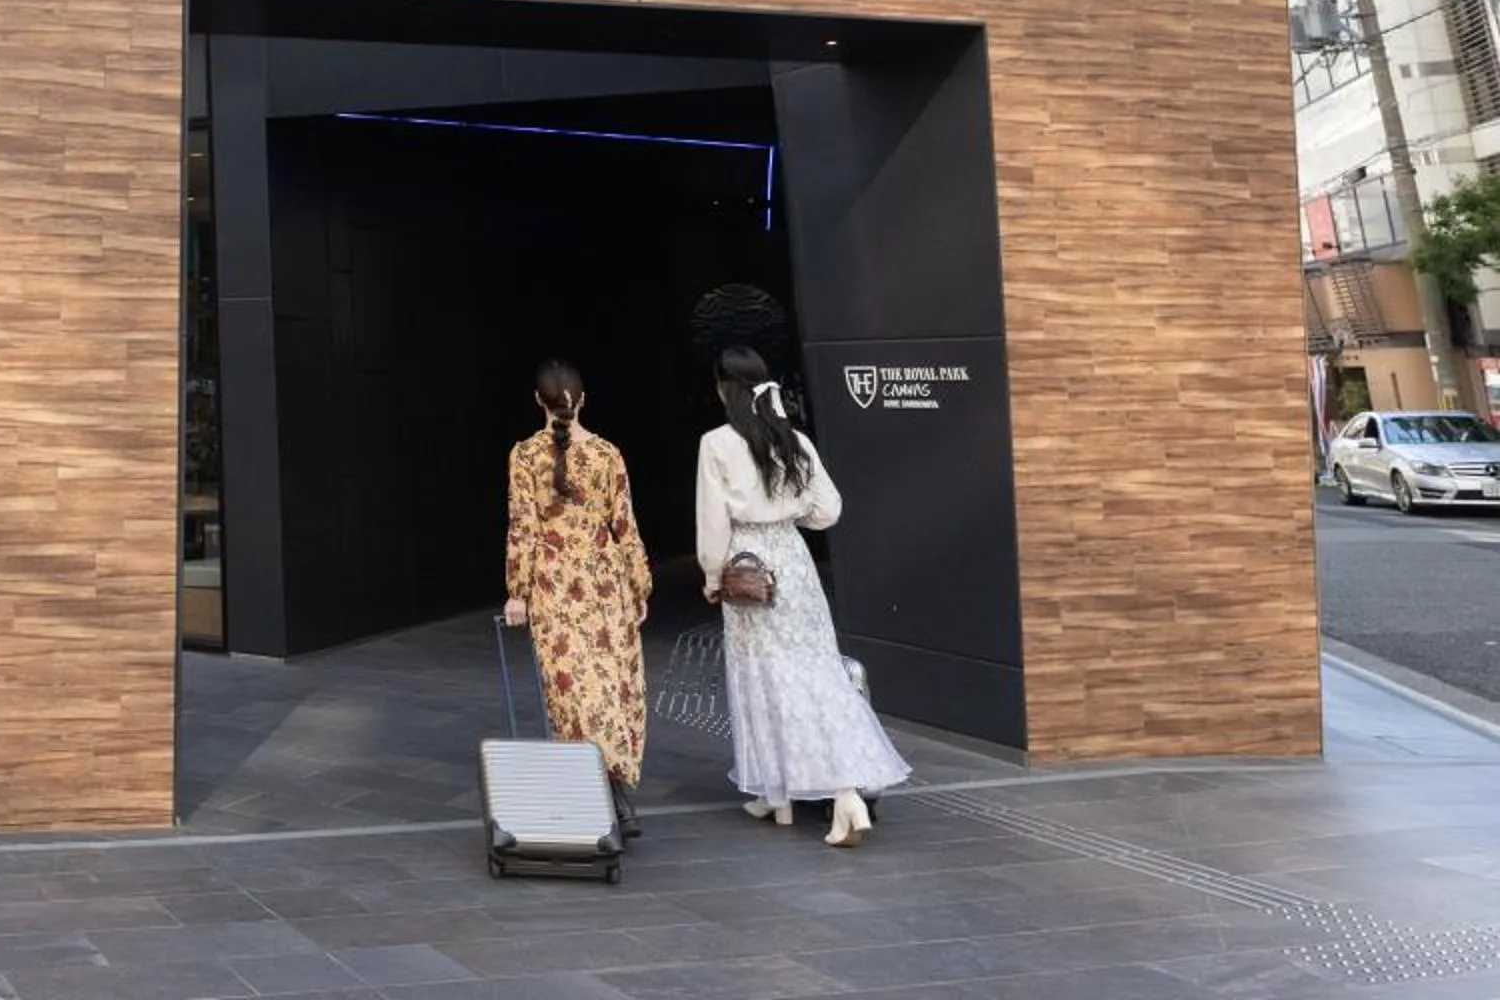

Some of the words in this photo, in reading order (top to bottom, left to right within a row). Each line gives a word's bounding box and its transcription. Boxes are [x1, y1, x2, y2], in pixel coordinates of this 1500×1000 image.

[879, 367, 903, 381] THE
[903, 367, 938, 381] ROYAL
[939, 367, 970, 381] PARK
[881, 383, 931, 397] CANVAS
